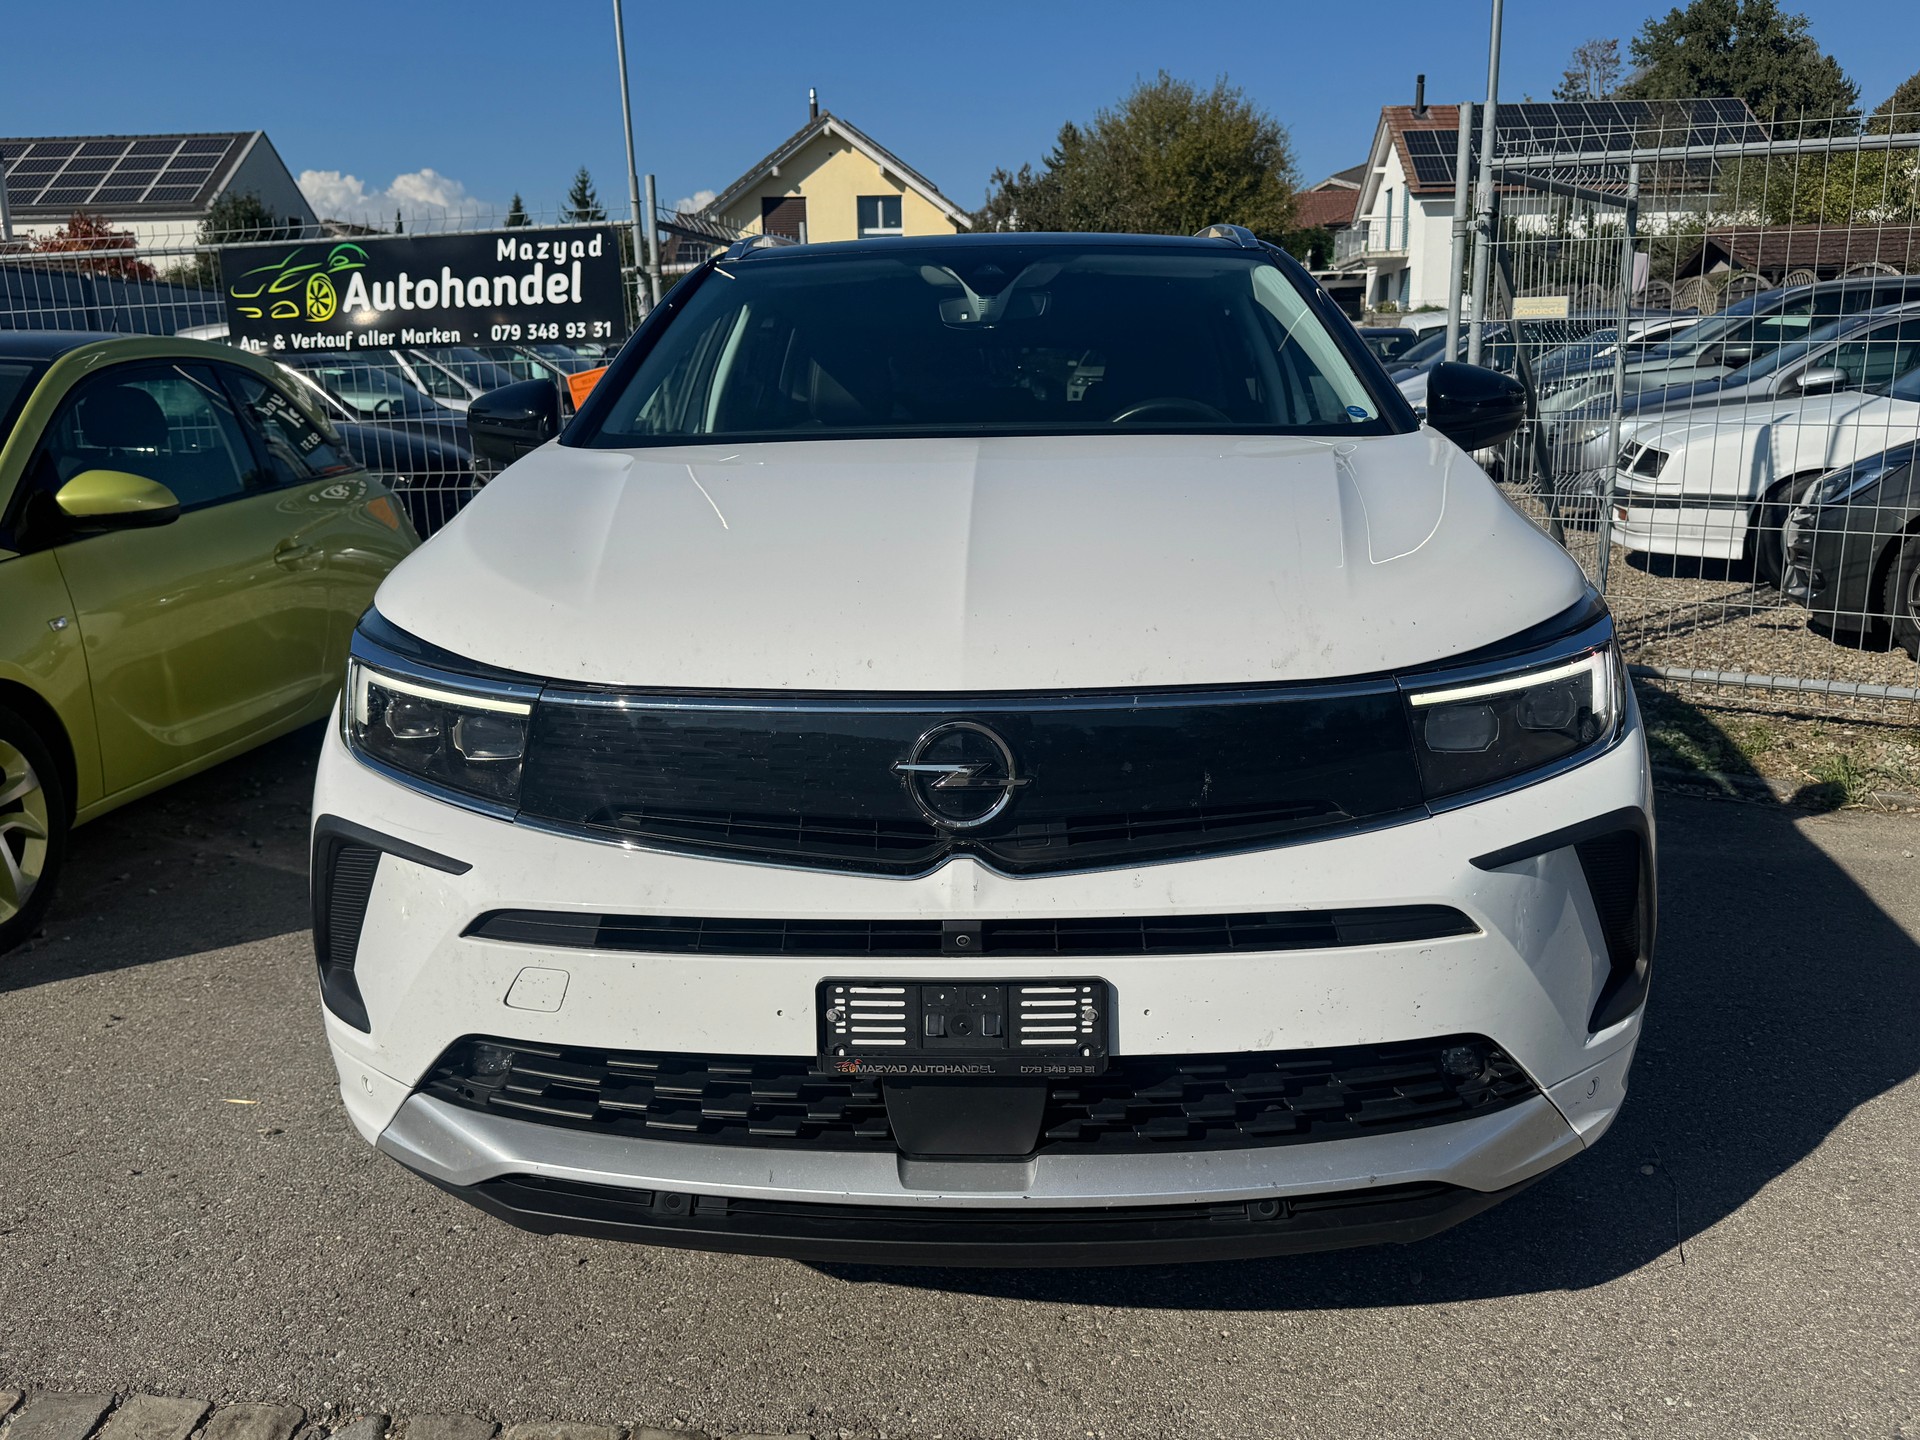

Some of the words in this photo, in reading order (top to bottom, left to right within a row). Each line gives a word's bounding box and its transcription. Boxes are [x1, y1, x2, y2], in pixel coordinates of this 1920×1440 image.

[496, 233, 603, 266] Mazyad
[342, 261, 582, 313] Autohandel
[239, 335, 268, 351] An-
[273, 333, 286, 350] &
[290, 330, 354, 351] Verkauf
[358, 329, 396, 347] aller
[402, 327, 461, 345] Marken
[491, 323, 522, 342] 079
[527, 322, 560, 340] 348
[565, 322, 587, 340] 93
[593, 320, 612, 338] 31
[855, 1064, 908, 1074] MAZYAD
[909, 1064, 997, 1074] AUTOHANDEL
[1043, 1065, 1067, 1074] 348
[1068, 1065, 1083, 1074] 93
